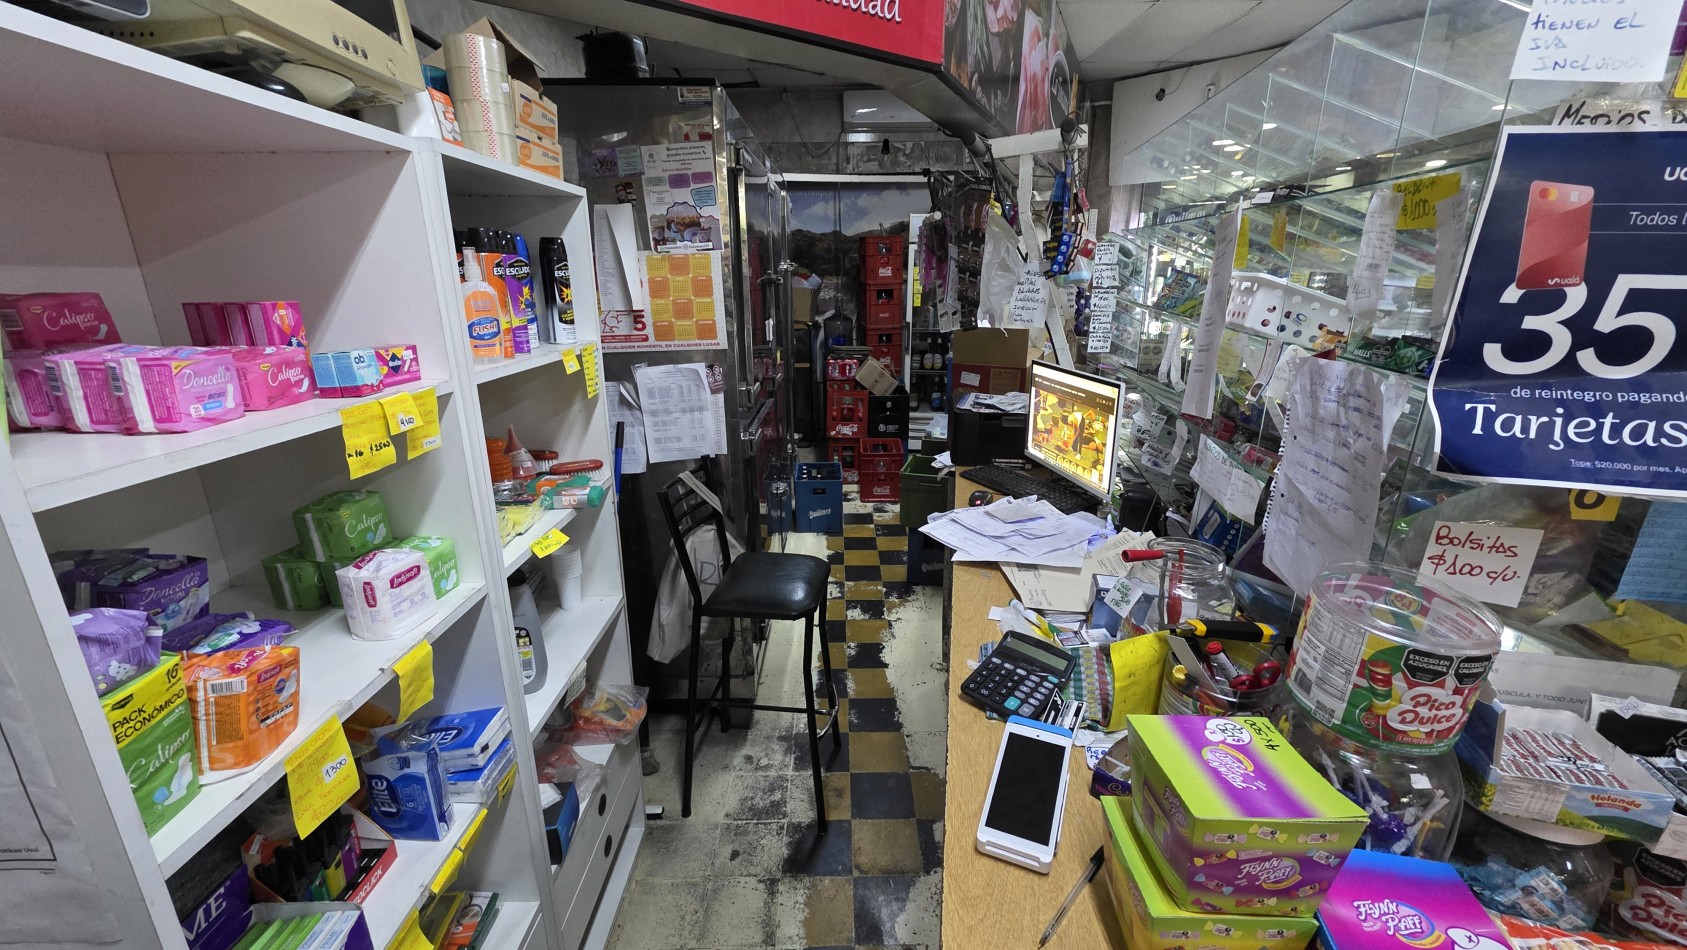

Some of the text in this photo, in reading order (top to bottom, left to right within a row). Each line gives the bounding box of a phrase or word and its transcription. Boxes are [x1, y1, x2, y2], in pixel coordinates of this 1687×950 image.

[1614, 12, 1646, 30] EL
[1629, 212, 1677, 225] Todos
[1561, 275, 1580, 285] ualá
[43, 309, 96, 331] Calipso
[1482, 273, 1677, 380] 35
[1353, 348, 1372, 358] HALLS
[182, 366, 231, 389] Doncella
[268, 365, 301, 387] Calipso
[1510, 386, 1530, 398] de
[1536, 388, 1612, 402] reintegro
[1465, 404, 1687, 450] Tarjetas
[1570, 458, 1594, 468] Tope:
[1595, 460, 1632, 470] $20.000
[1633, 464, 1648, 472] por
[345, 512, 384, 538] Calipso
[1435, 525, 1519, 557] Bolsitas
[433, 560, 456, 581] alipso
[140, 575, 199, 605] Doncella
[1409, 654, 1438, 664] EXCESO
[165, 662, 180, 684] 16
[1410, 693, 1457, 712] Pico
[1542, 694, 1566, 703] TODO
[112, 704, 147, 733] PACK
[115, 688, 184, 744] ECONÓMICO
[1397, 709, 1456, 726] Dulce
[127, 728, 190, 786] Calipso
[372, 778, 398, 814] Elite
[1590, 794, 1642, 810] Holanda
[1237, 858, 1281, 878] FLYNN
[1255, 866, 1292, 884] PAFF
[1353, 899, 1398, 920] FLYNN
[1382, 915, 1422, 935] PAFF
